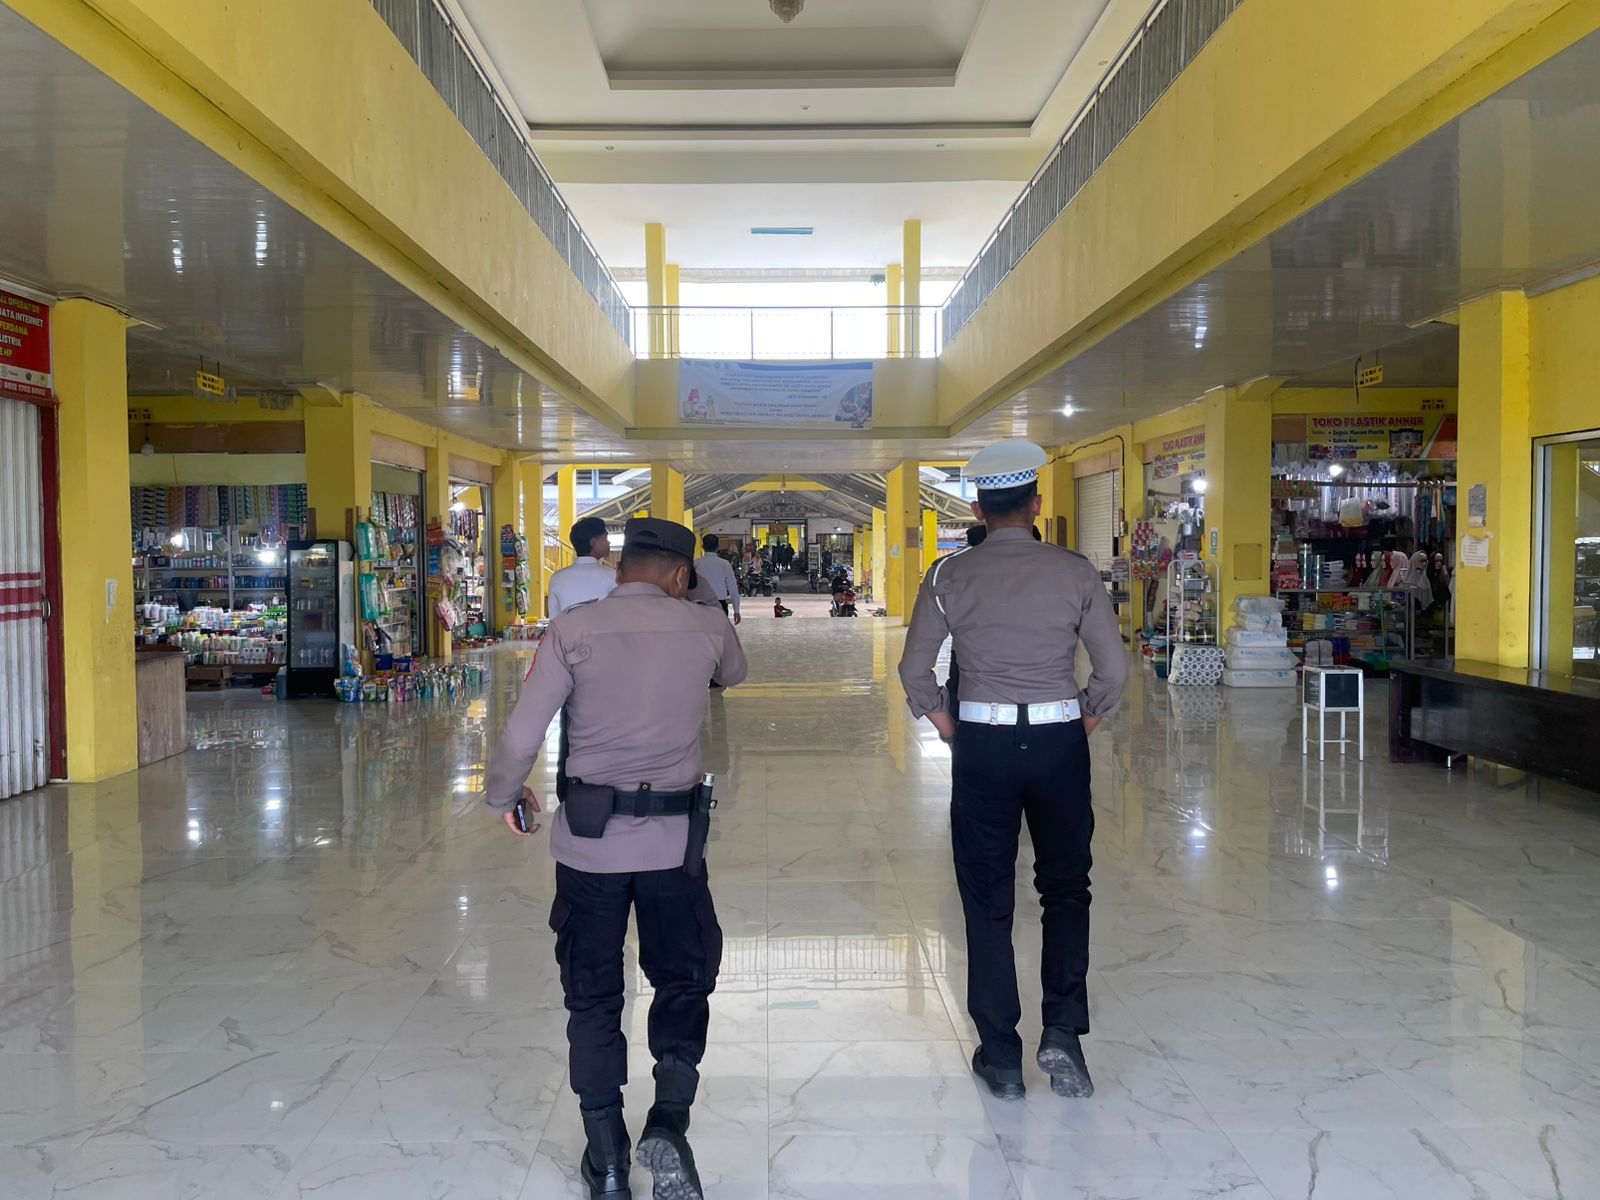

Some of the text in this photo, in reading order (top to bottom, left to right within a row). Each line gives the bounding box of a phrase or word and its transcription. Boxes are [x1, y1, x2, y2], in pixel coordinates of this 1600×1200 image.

[8, 298, 40, 313] OPERATOR
[15, 312, 44, 328] INTERNET
[0, 320, 28, 336] PERDANA
[0, 333, 22, 347] LISTRIK
[1312, 417, 1342, 427] TOKO
[1344, 417, 1387, 426] PLASTIK
[1175, 435, 1193, 449] PLASTIK
[1193, 432, 1205, 444] ANN
